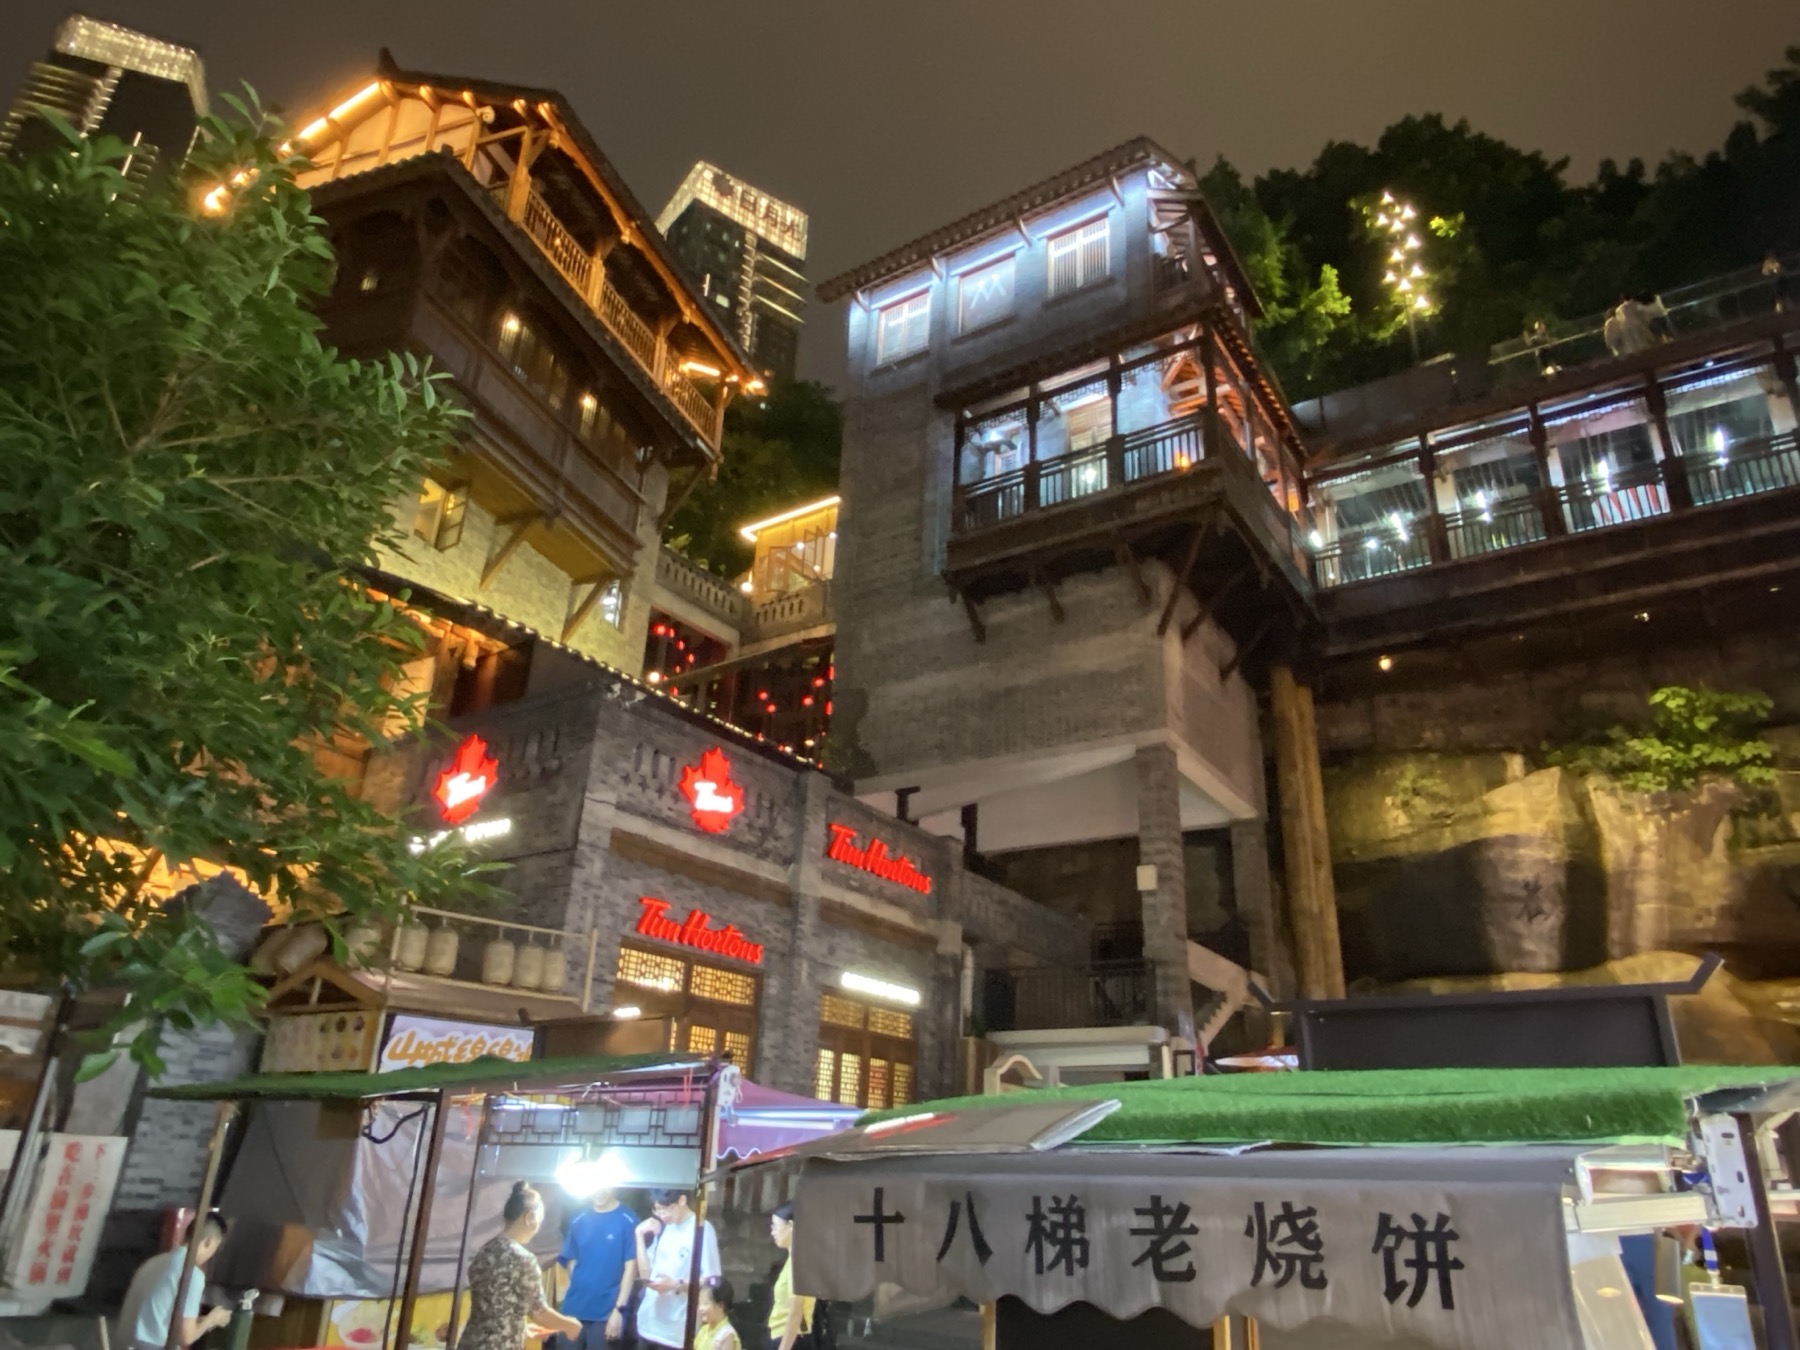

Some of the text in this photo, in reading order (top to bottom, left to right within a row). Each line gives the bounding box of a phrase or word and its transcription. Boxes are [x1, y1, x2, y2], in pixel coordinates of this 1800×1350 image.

[740, 189, 801, 241] 日月光
[828, 823, 932, 895] Tim Hortons
[637, 896, 763, 964] Tim Hortons
[853, 1187, 1465, 1310] 十八梯老烧饼
